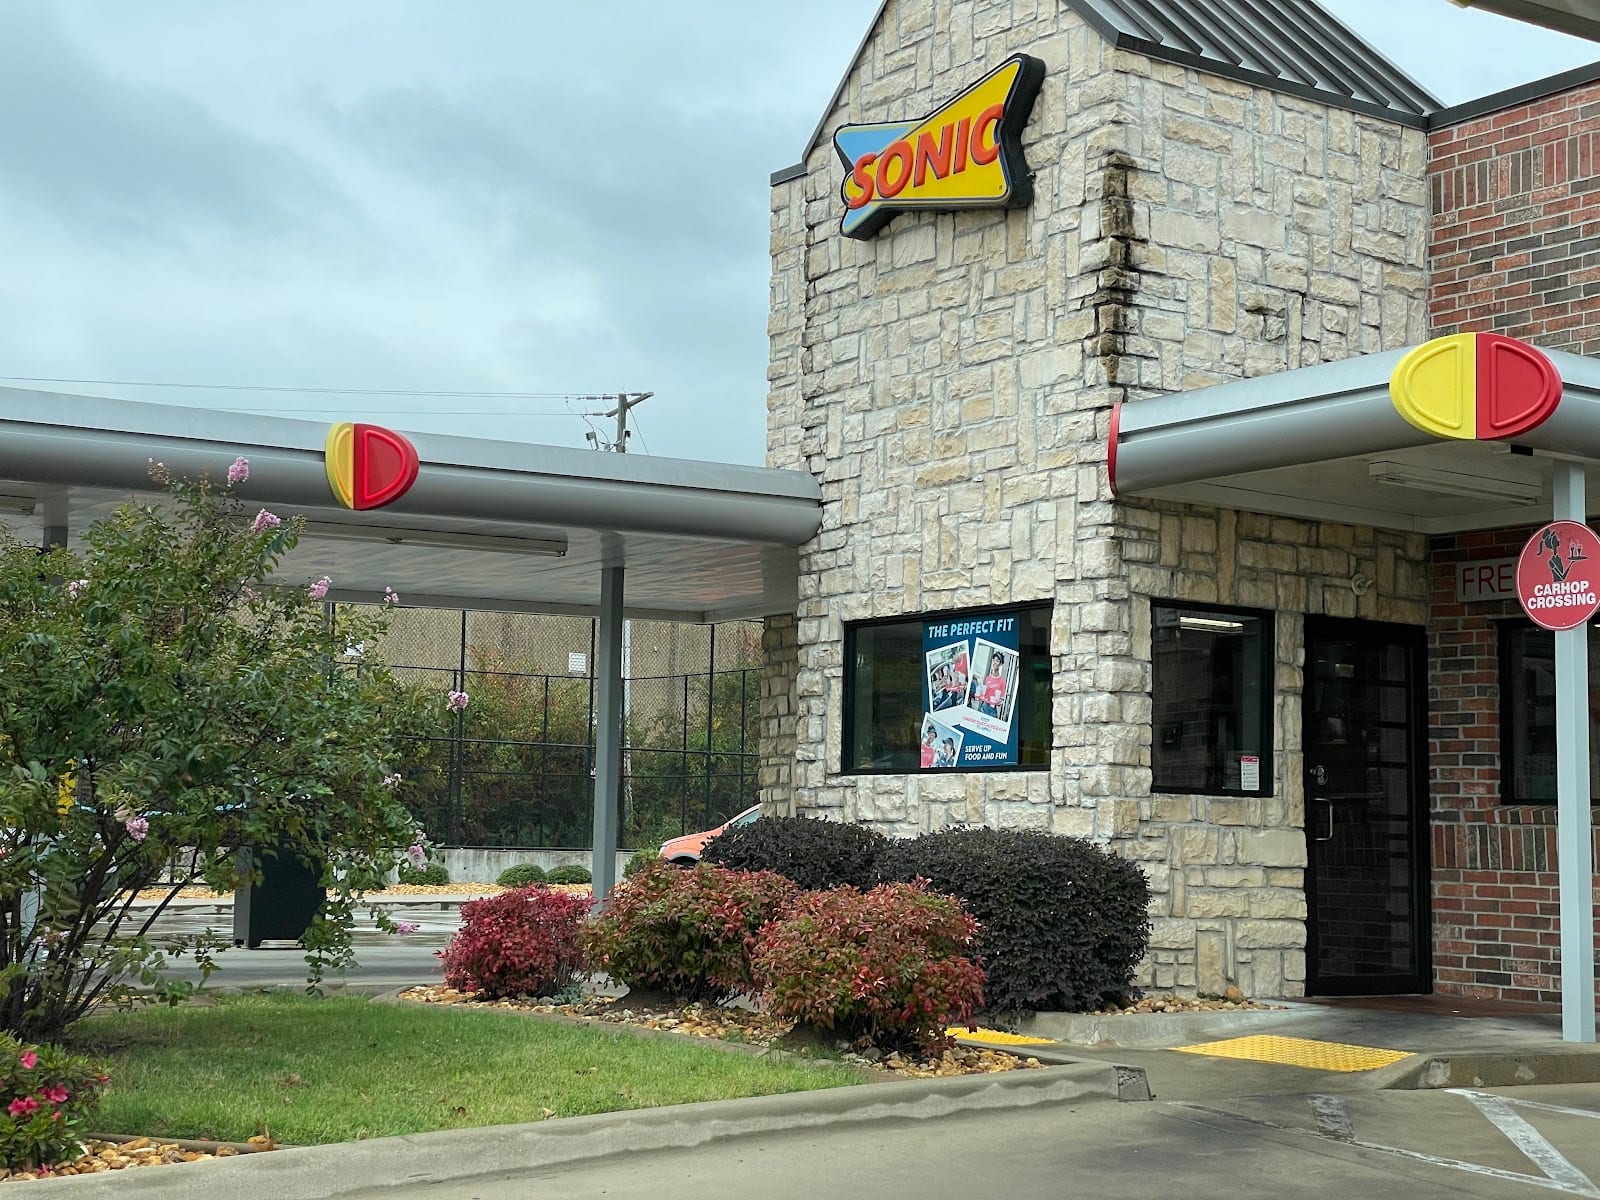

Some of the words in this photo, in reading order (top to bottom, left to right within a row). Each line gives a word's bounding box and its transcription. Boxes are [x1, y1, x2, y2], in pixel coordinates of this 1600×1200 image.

[848, 103, 1005, 210] SONIC
[1462, 563, 1514, 596] FRE
[1534, 581, 1590, 597] CARHOP
[1527, 592, 1596, 610] CROSSING
[928, 624, 949, 639] THE
[950, 620, 996, 637] PERFECT
[996, 618, 1014, 632] FIT
[964, 745, 984, 753] SERVE
[983, 744, 992, 753] UP
[964, 753, 982, 761] FOOD
[981, 752, 995, 761] AND
[995, 752, 1008, 760] FUN
